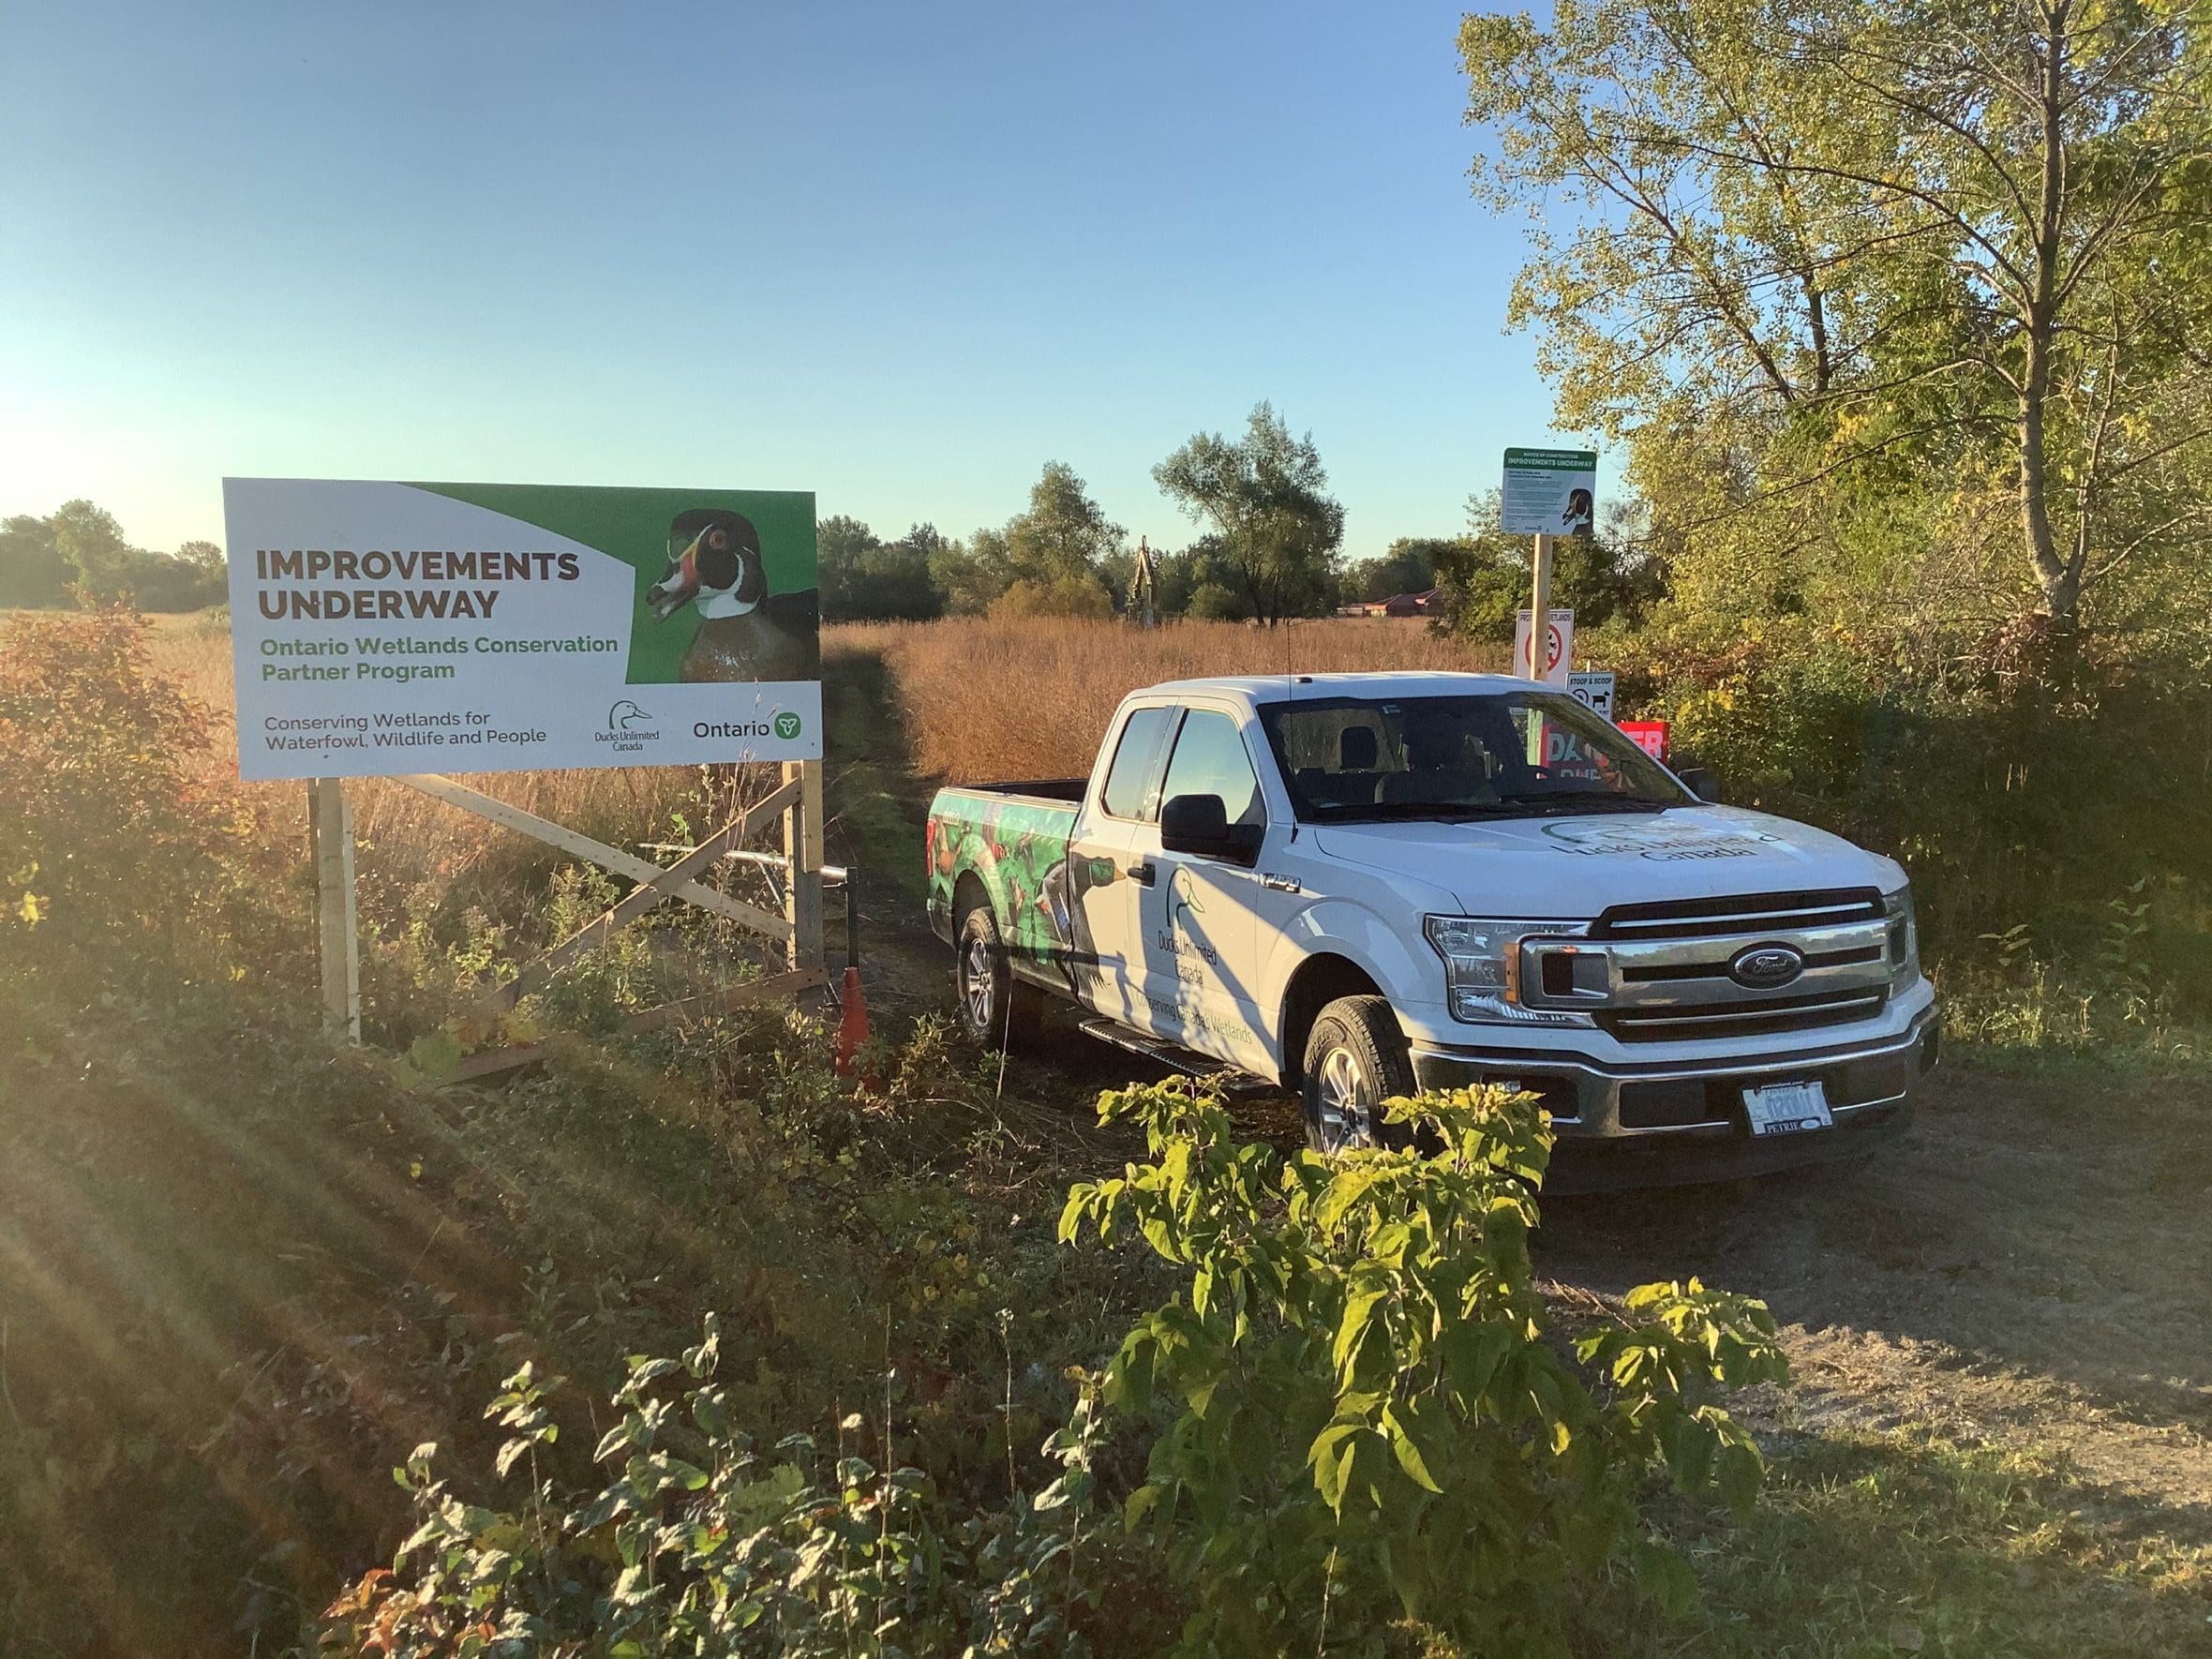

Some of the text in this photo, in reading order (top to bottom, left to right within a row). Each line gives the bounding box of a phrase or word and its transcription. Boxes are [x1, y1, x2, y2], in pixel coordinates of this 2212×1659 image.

[1508, 457, 1593, 468] IMPROVEMENTS UNDERWAY
[256, 549, 580, 581] IMPROVEMENTS
[258, 590, 500, 620] UNDERWAY
[1551, 613, 1571, 621] ETLANDS
[260, 635, 619, 656] Ontario Wetlands Conservation
[262, 663, 456, 683] Partner Program
[1593, 677, 1612, 685] SCOOP
[264, 710, 491, 732] Conserving Wetlands for
[694, 721, 770, 738] Ontario
[265, 728, 547, 750] Waterfowl, Wildlife and People
[595, 730, 659, 741] Ducks Unlimited
[1547, 730, 1663, 761] DAER
[613, 742, 643, 752] Canada
[1640, 847, 1757, 861] Canada
[1158, 930, 1218, 965] Ducks Unlimited
[1175, 959, 1203, 985] Canada
[1754, 956, 1787, 975] Ford
[1177, 1004, 1210, 1030] Canada's
[1211, 1015, 1252, 1044] Wetlands
[1766, 1121, 1800, 1134] PETRIE
